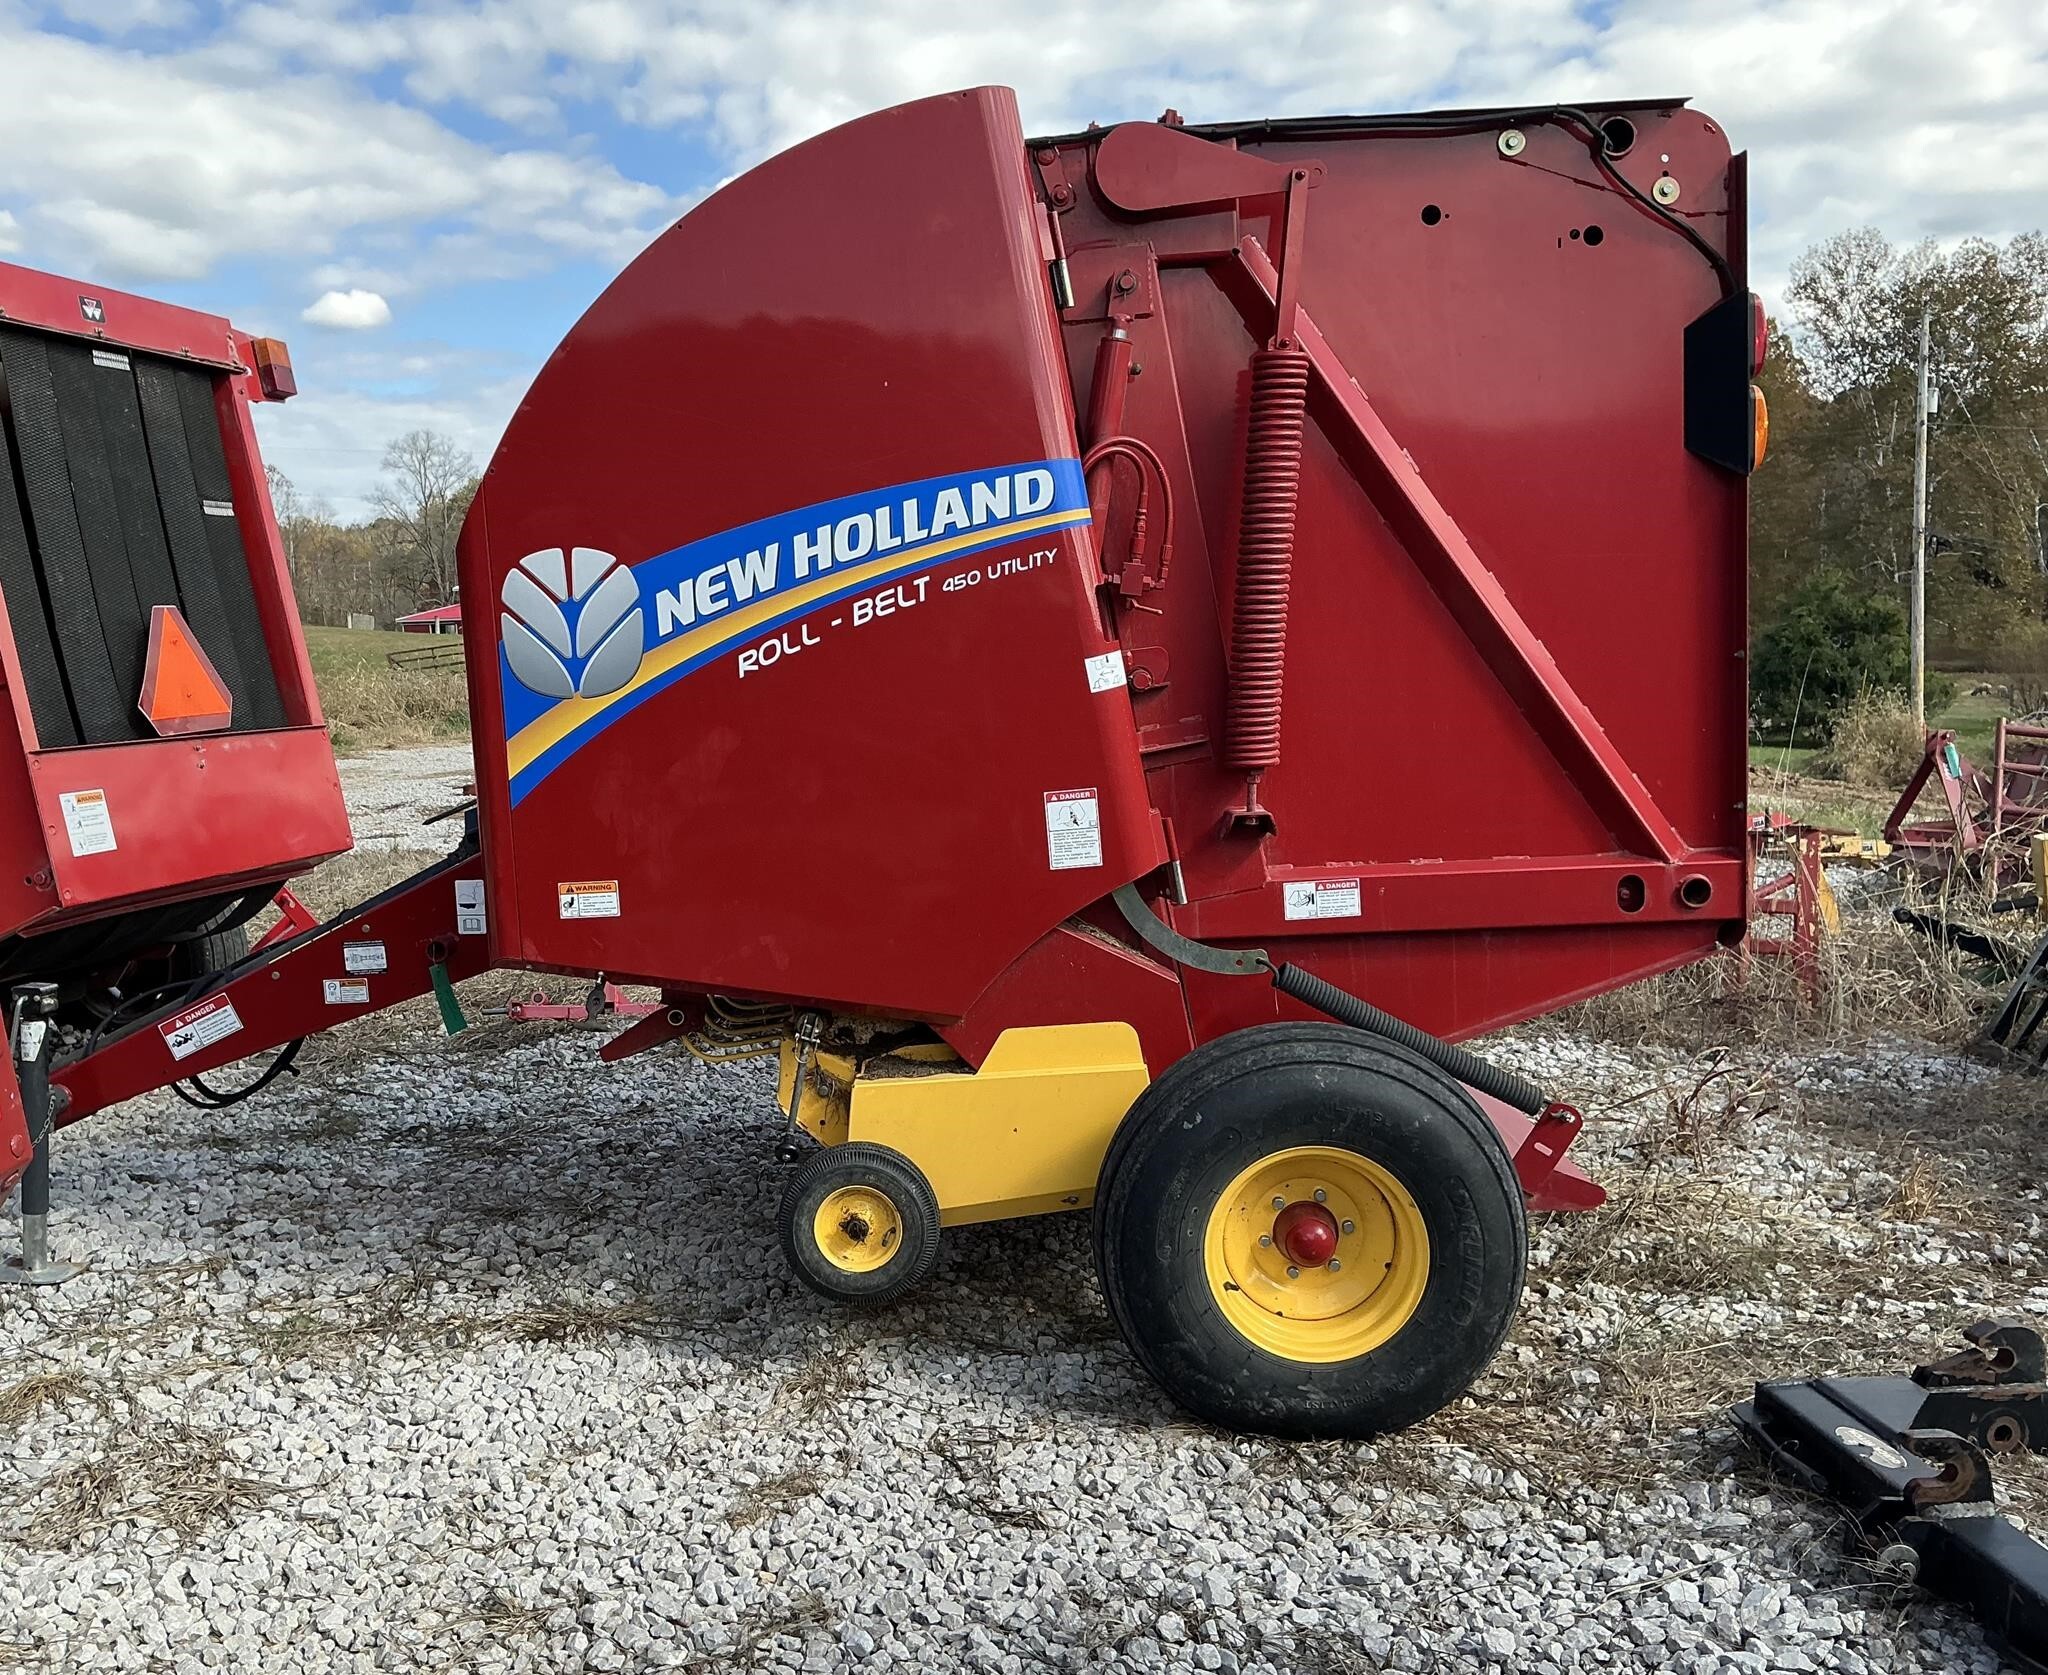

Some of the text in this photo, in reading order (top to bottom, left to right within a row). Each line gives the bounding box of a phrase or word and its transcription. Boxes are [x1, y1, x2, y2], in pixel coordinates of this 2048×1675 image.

[655, 468, 1055, 638] NEW HOLLAND
[941, 547, 1059, 593] 450 UTILITY
[738, 623, 821, 679] ROLL
[852, 575, 931, 627] BELT
[1059, 791, 1091, 800] DANGER
[575, 884, 612, 892] WARNING
[1325, 881, 1356, 890] DANGER
[184, 1002, 217, 1023] DANGER
